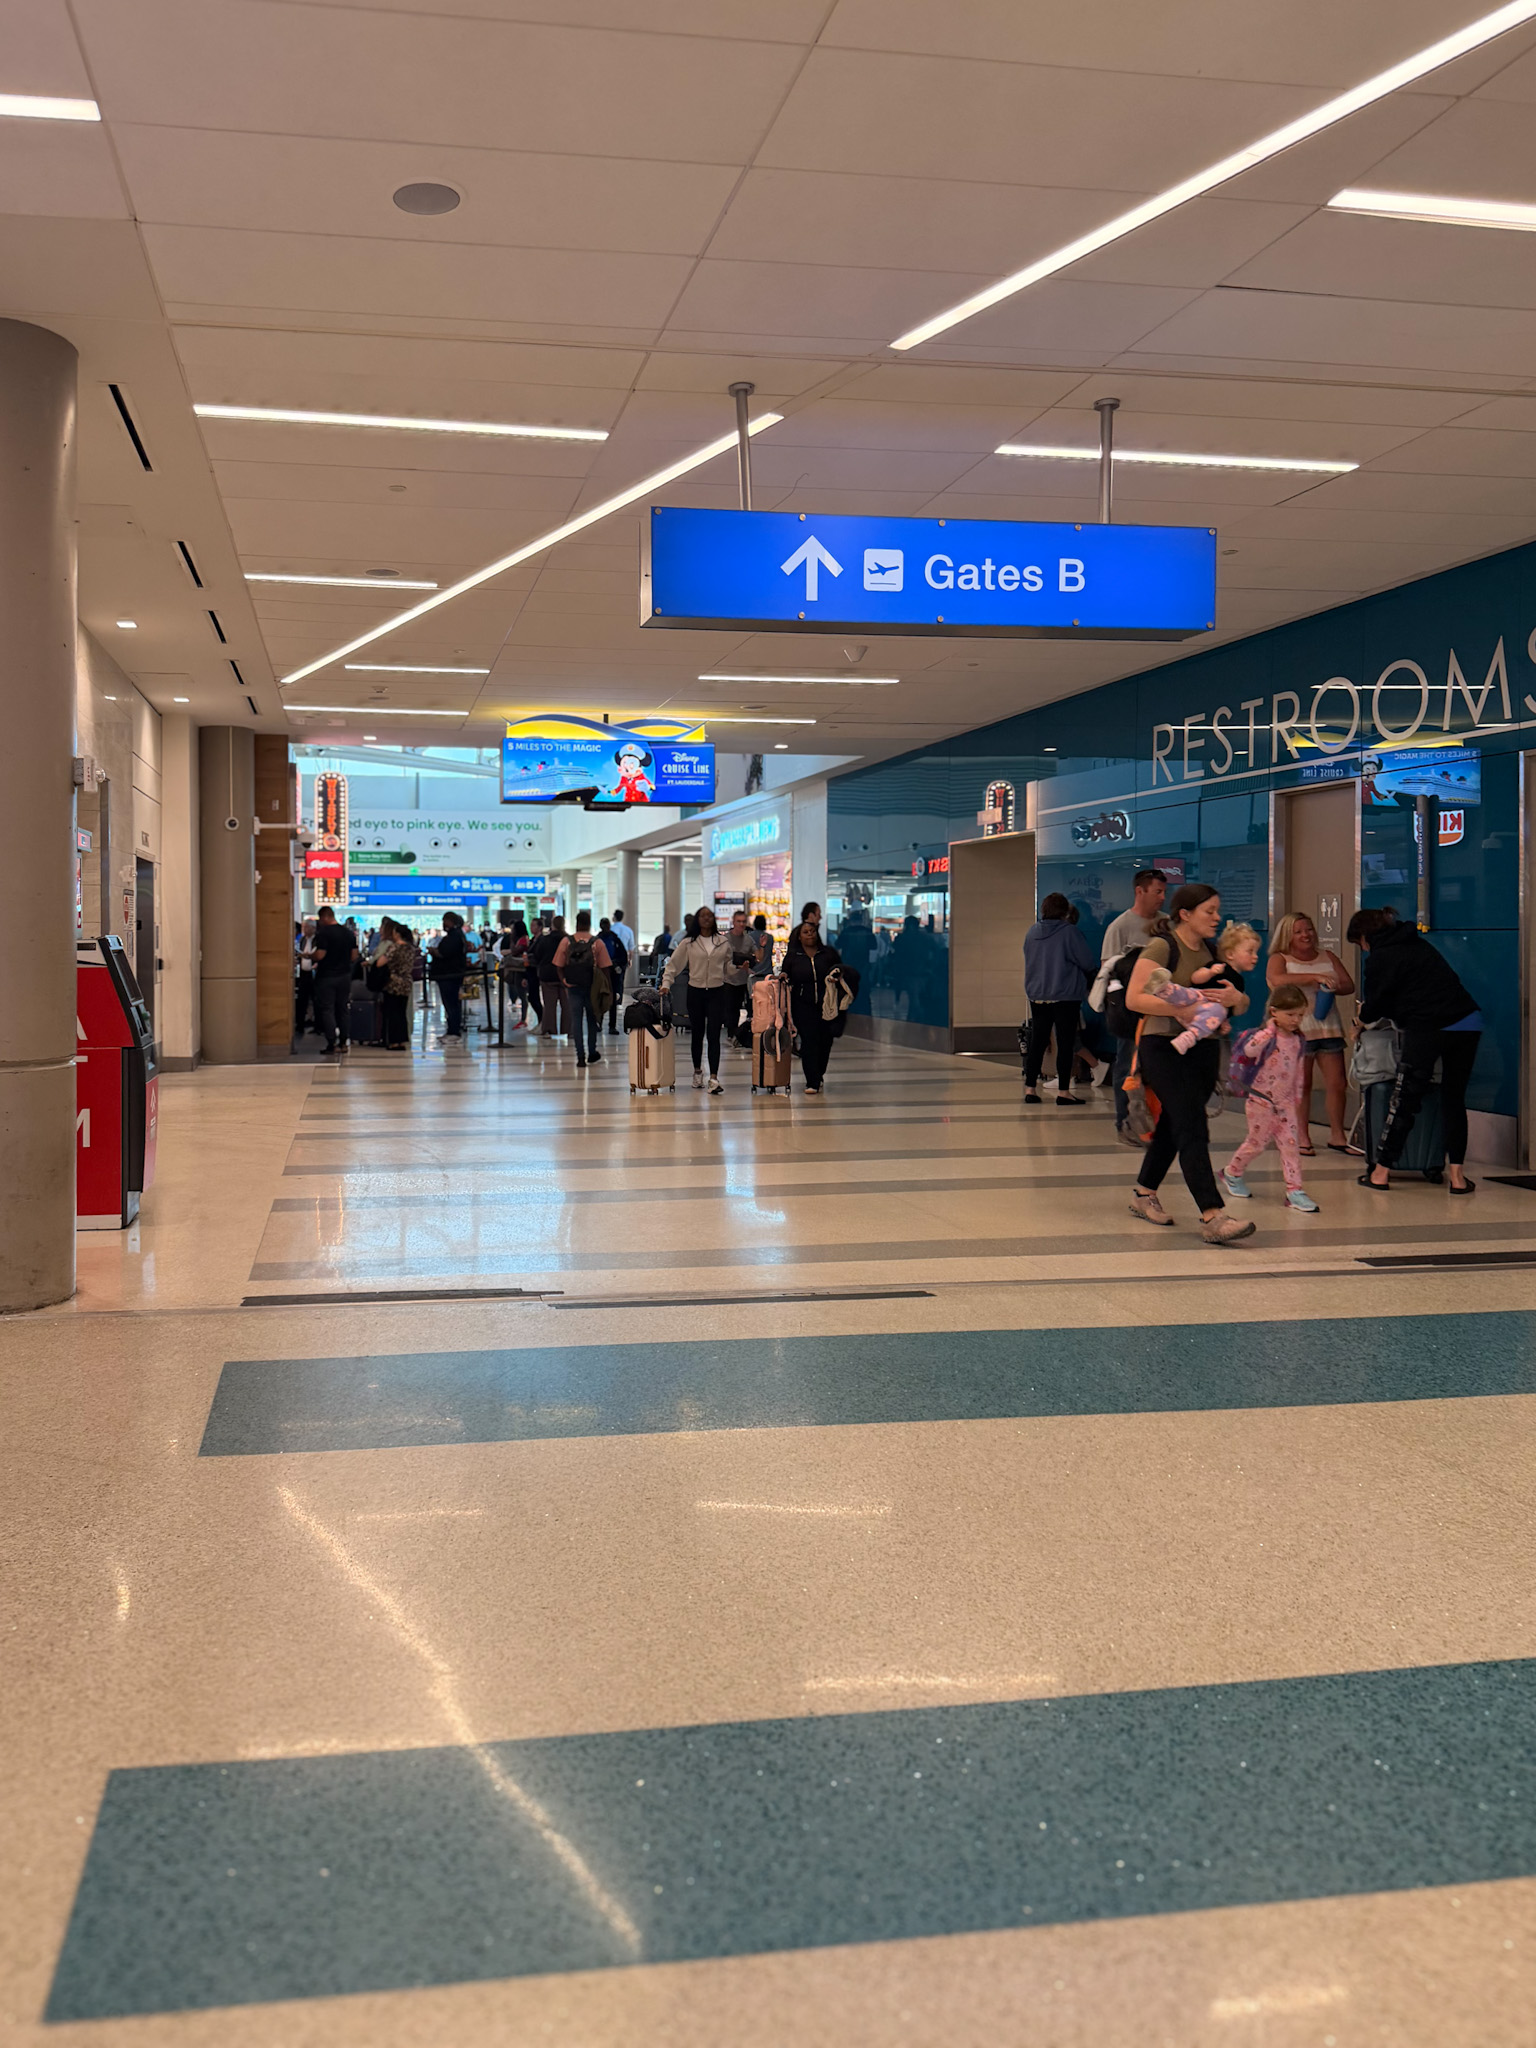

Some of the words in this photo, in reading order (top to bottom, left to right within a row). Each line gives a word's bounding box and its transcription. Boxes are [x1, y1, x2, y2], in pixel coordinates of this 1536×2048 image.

[924, 554, 1043, 591] Gates
[1058, 558, 1086, 592] B
[508, 742, 514, 750] 5
[515, 743, 540, 751] MILES
[541, 743, 553, 751] TO
[555, 743, 571, 752] THE
[573, 744, 601, 752] MAGIC
[671, 752, 700, 764] Disney
[662, 764, 690, 774] CRUISE
[693, 764, 710, 774] LINE
[348, 818, 361, 829] ed
[364, 820, 388, 832] eye
[391, 820, 404, 829] to
[407, 818, 435, 832] pink
[438, 821, 464, 833] eye.
[468, 820, 488, 830] We
[491, 822, 513, 831] see
[515, 822, 542, 834] you.
